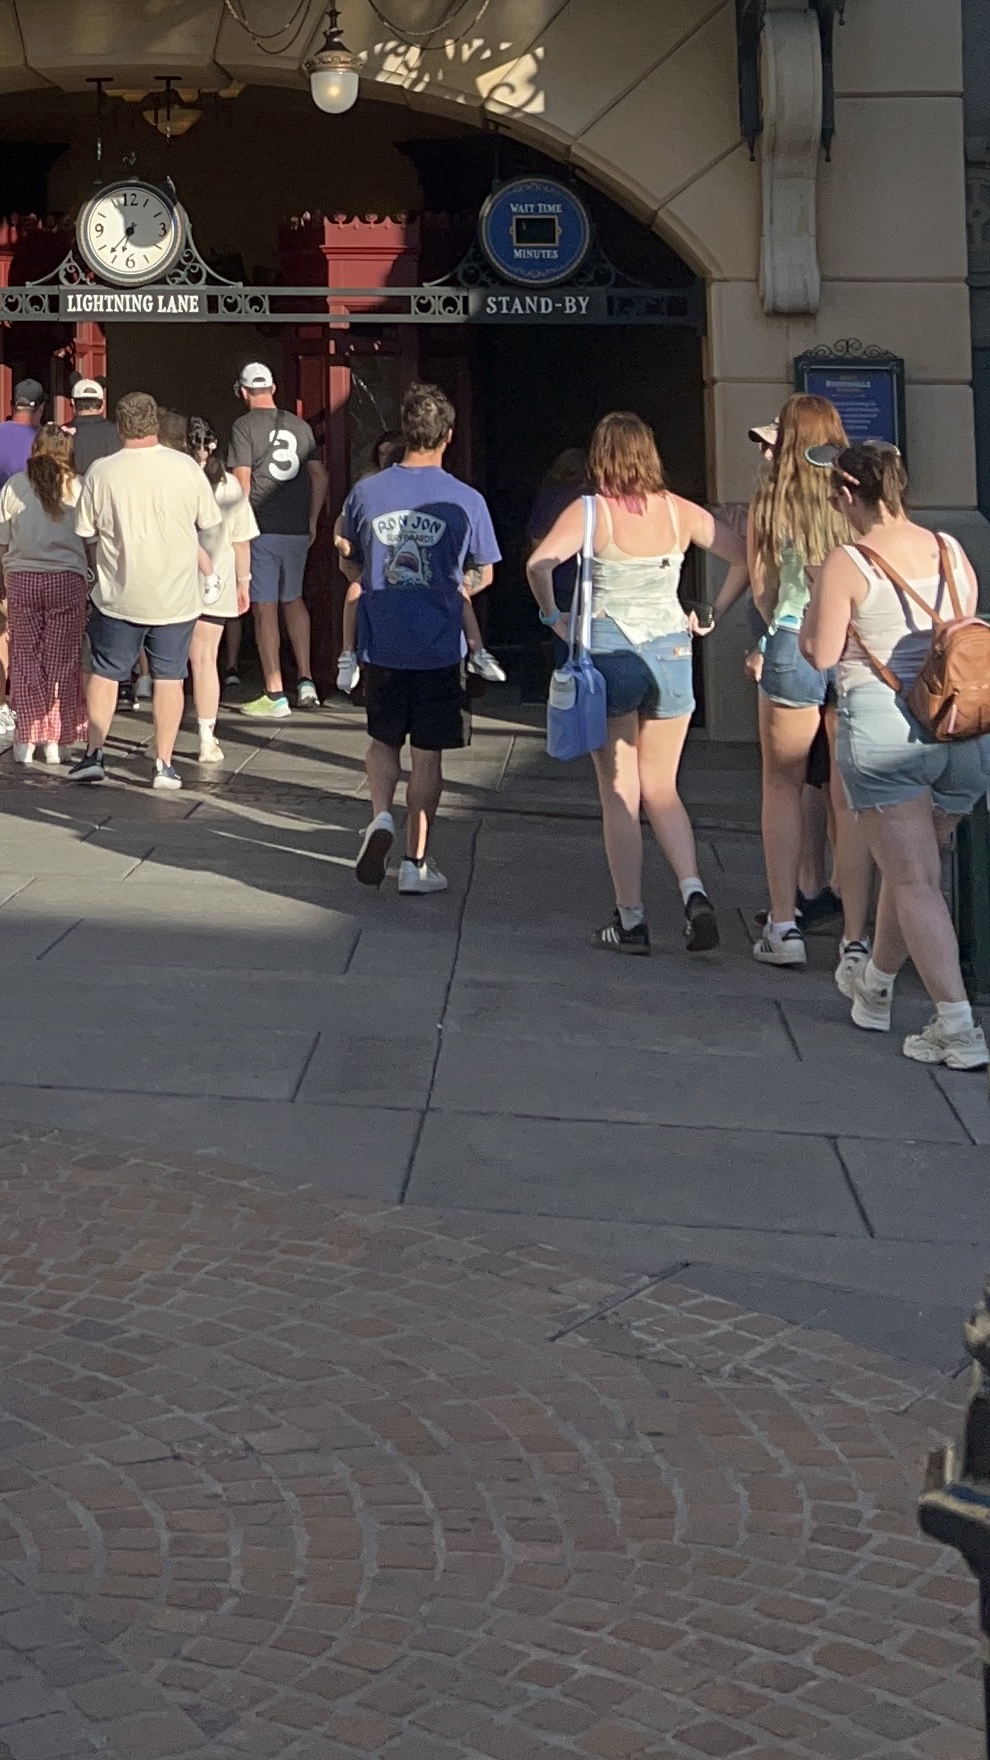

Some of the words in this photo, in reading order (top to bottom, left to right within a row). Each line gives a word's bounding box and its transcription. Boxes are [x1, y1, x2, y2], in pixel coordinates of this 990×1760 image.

[122, 193, 139, 207] 12
[509, 202, 535, 213] WAIT
[537, 202, 562, 213] TIME
[94, 223, 105, 238] 9
[158, 222, 167, 237] 3
[125, 252, 136, 269] 6
[513, 248, 559, 259] MINUTES
[66, 293, 154, 313] LIGHTNING
[157, 294, 200, 314] LANE
[485, 295, 590, 315] STAND-BY
[268, 429, 301, 482] 3
[378, 515, 408, 534] RON
[411, 516, 442, 534] JON
